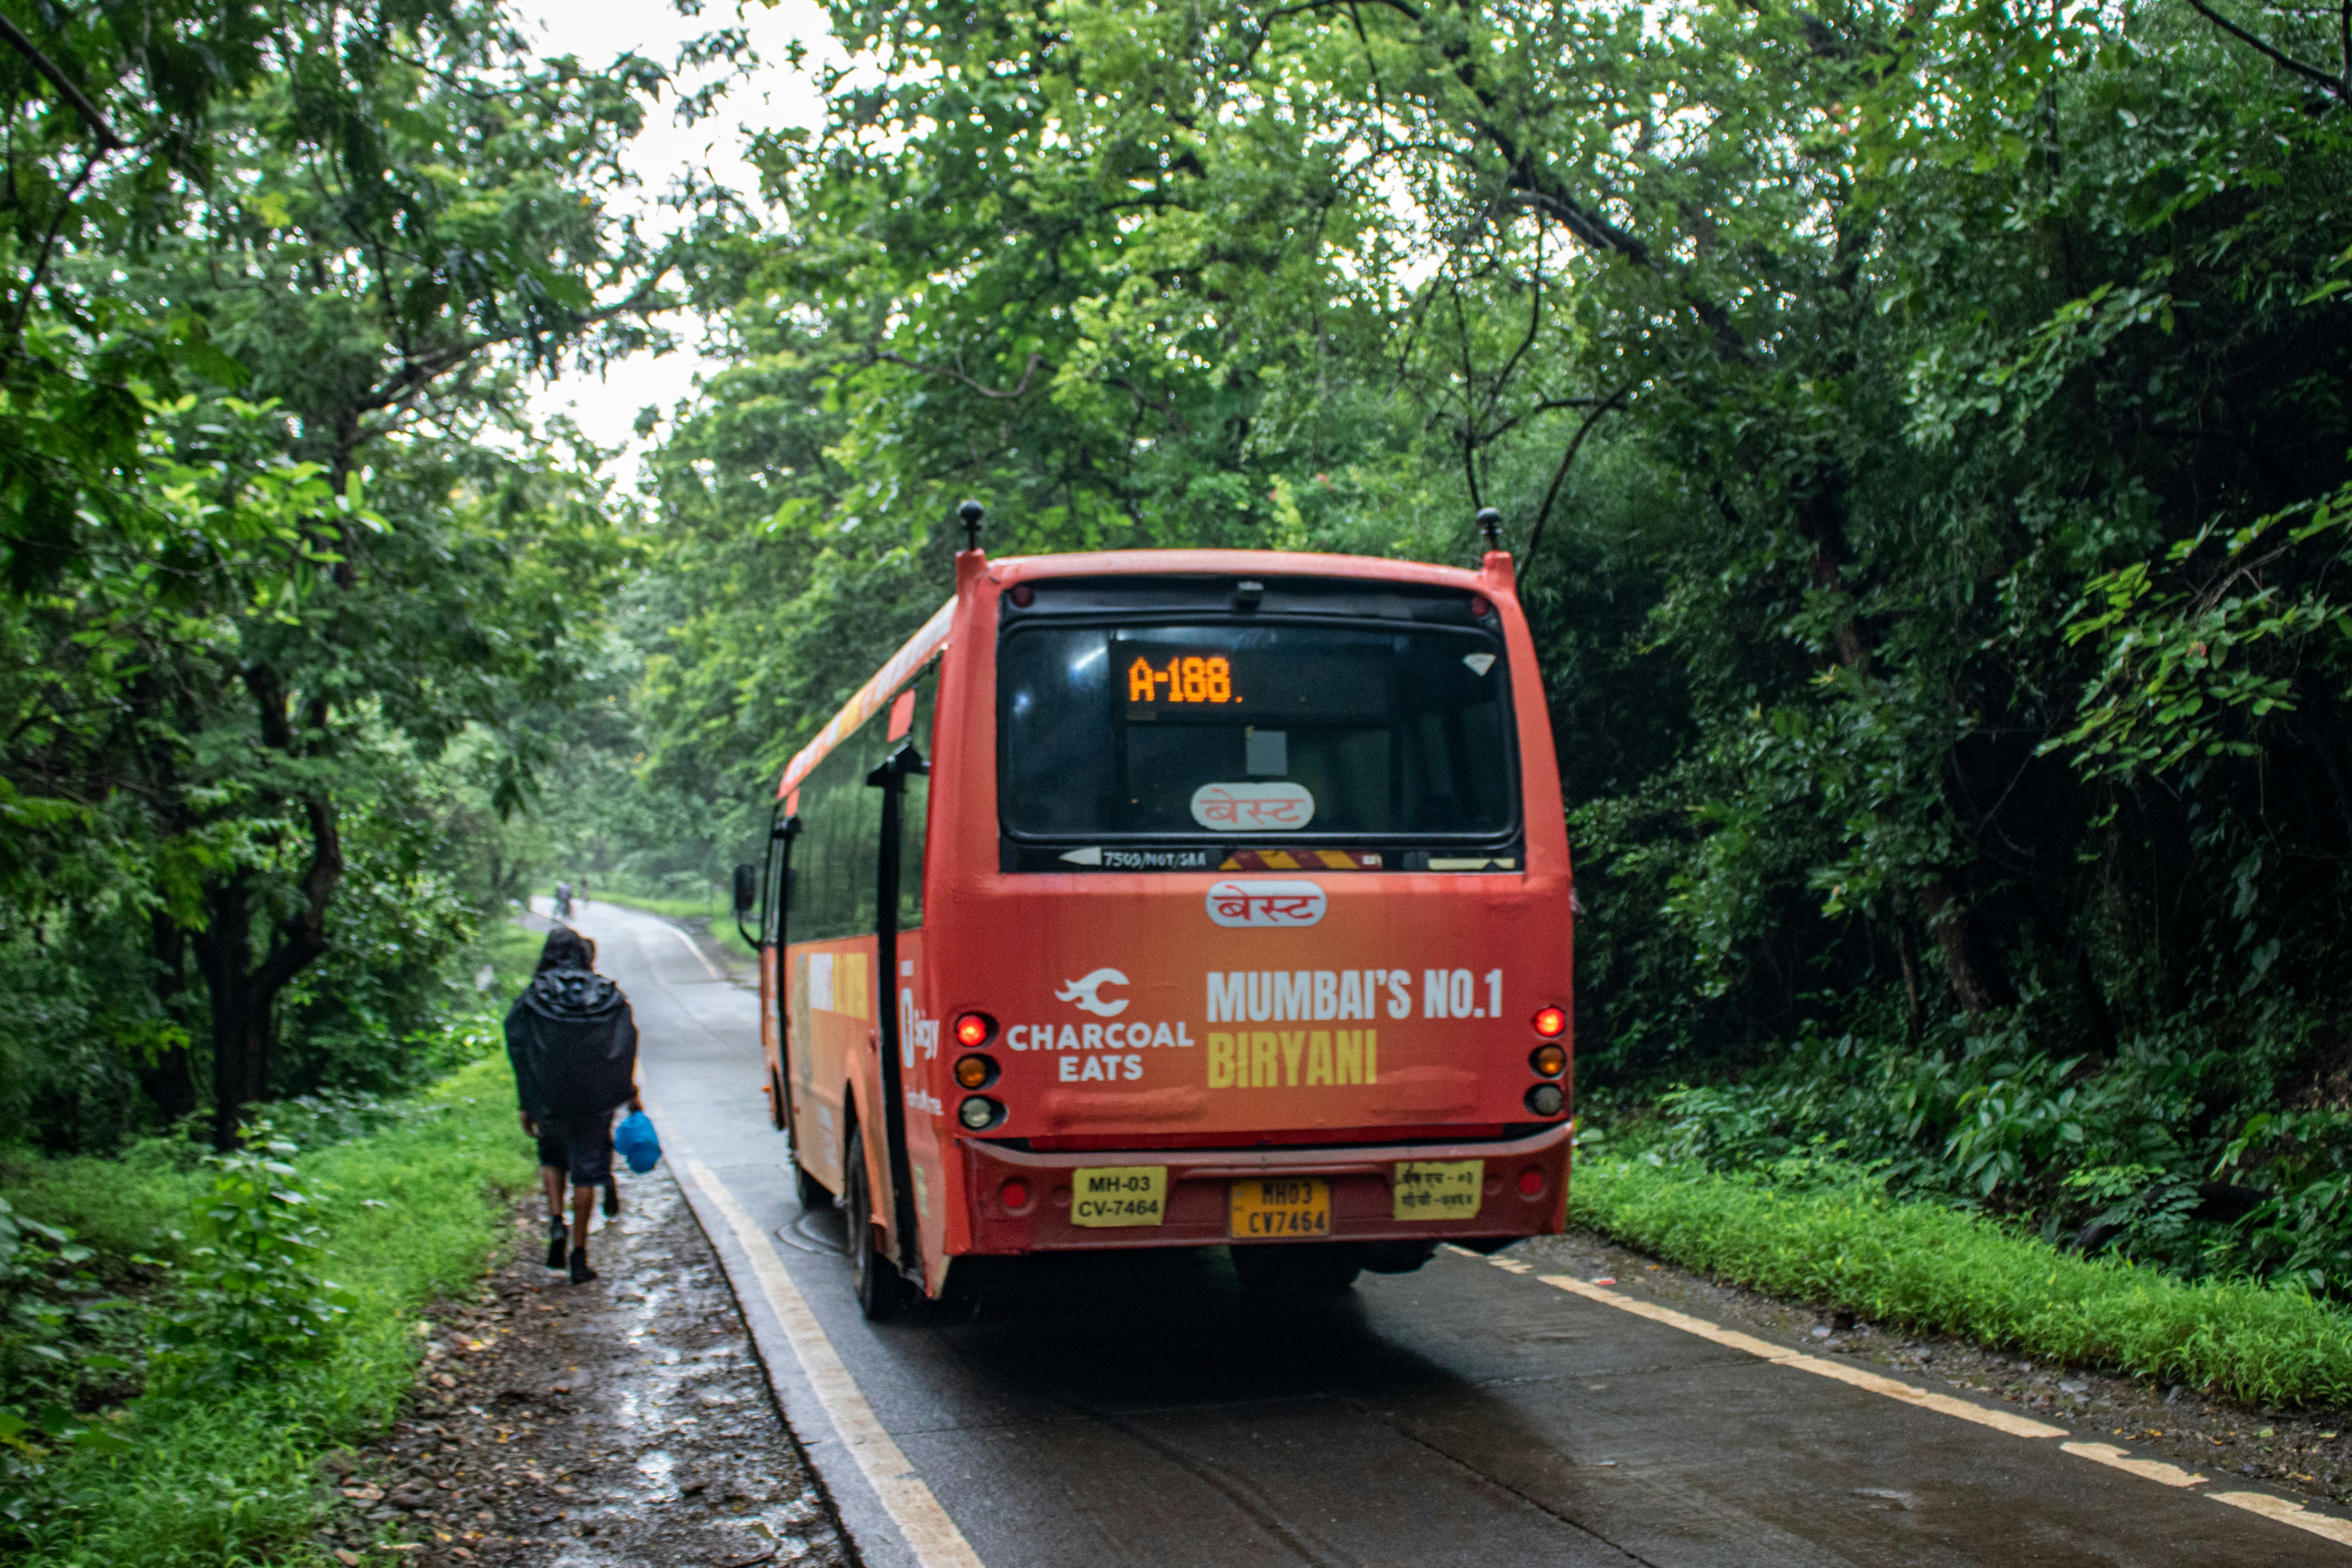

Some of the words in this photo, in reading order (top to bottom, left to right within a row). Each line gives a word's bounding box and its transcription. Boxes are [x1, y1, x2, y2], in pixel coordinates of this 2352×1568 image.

[1199, 787, 1304, 825] बेस्ट
[1212, 884, 1321, 922] बेस्ट
[1207, 969, 1412, 1022] MUMBAI'S
[1424, 969, 1502, 1018] NO.1
[1007, 1021, 1194, 1051] CHARCOAL
[1059, 1054, 1143, 1082] EATS
[1207, 1029, 1377, 1088] BIRYANI
[1089, 1176, 1150, 1192] MH-03
[1262, 1181, 1312, 1205] MH03
[1079, 1199, 1158, 1217] CV-7464
[1248, 1211, 1325, 1233] CV7464
